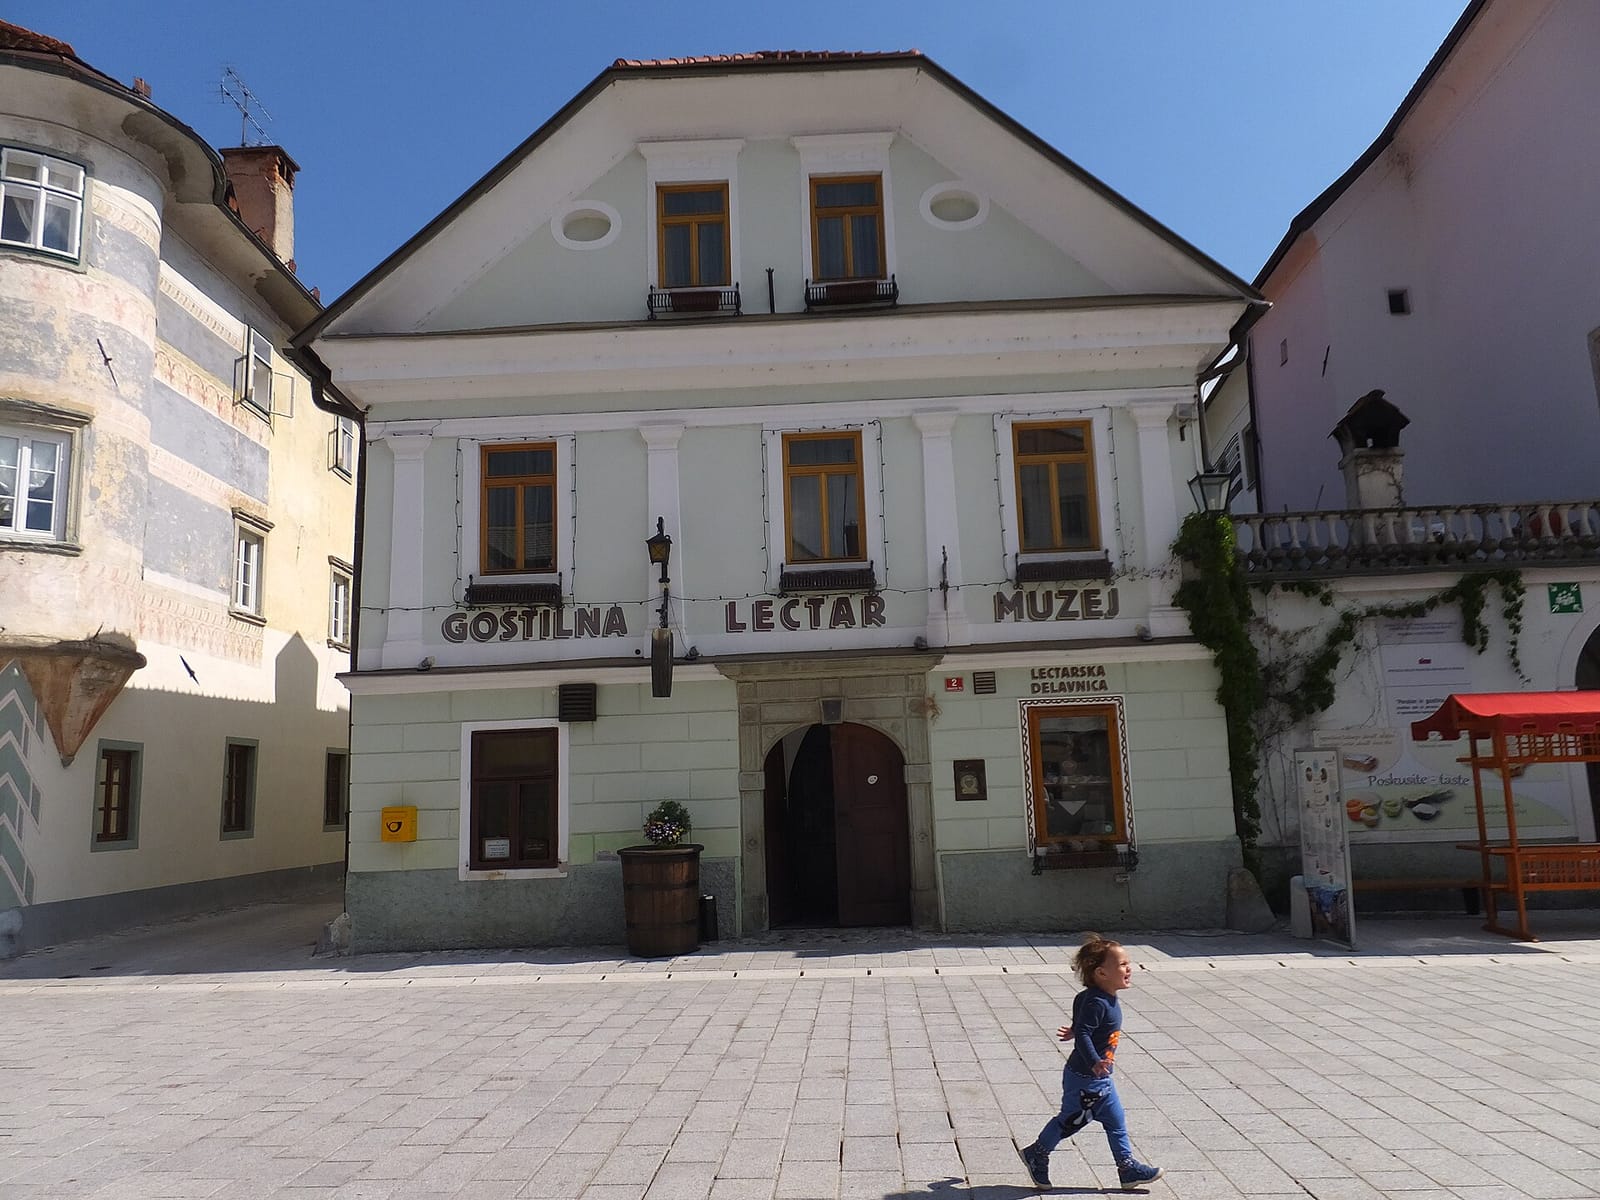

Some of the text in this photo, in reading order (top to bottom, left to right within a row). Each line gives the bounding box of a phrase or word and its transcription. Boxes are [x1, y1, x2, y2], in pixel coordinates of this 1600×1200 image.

[441, 588, 1120, 642] GOSTILNA LECTAR MUZEJ
[1030, 665, 1106, 680] LECTARSKA
[951, 678, 958, 687] 2
[1030, 680, 1108, 694] DELAVNICA
[1367, 772, 1428, 786] Poskusite
[1439, 774, 1470, 785] taste
